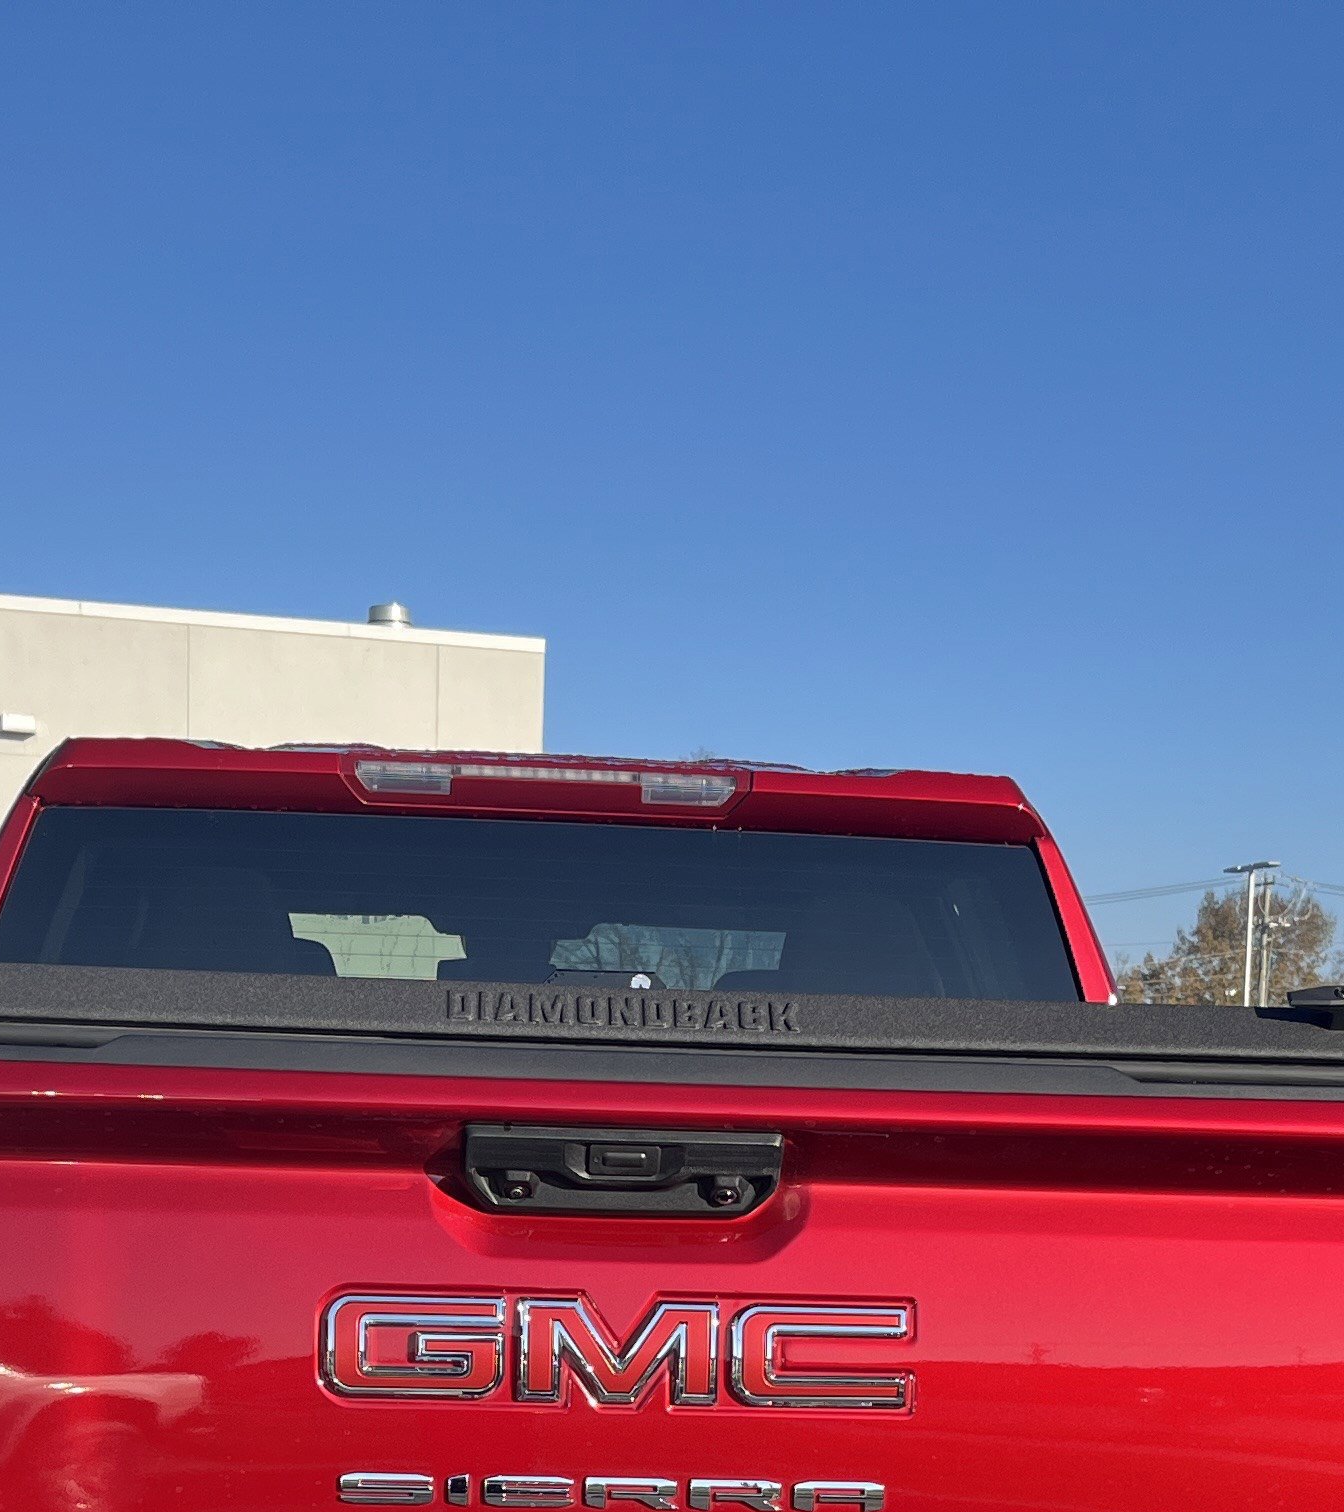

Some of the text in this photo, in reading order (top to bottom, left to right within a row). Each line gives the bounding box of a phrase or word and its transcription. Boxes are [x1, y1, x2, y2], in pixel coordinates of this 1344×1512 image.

[446, 988, 801, 1034] DIAMONDBACK
[316, 1290, 918, 1410] GMC
[336, 1473, 886, 1512] SIERRA
